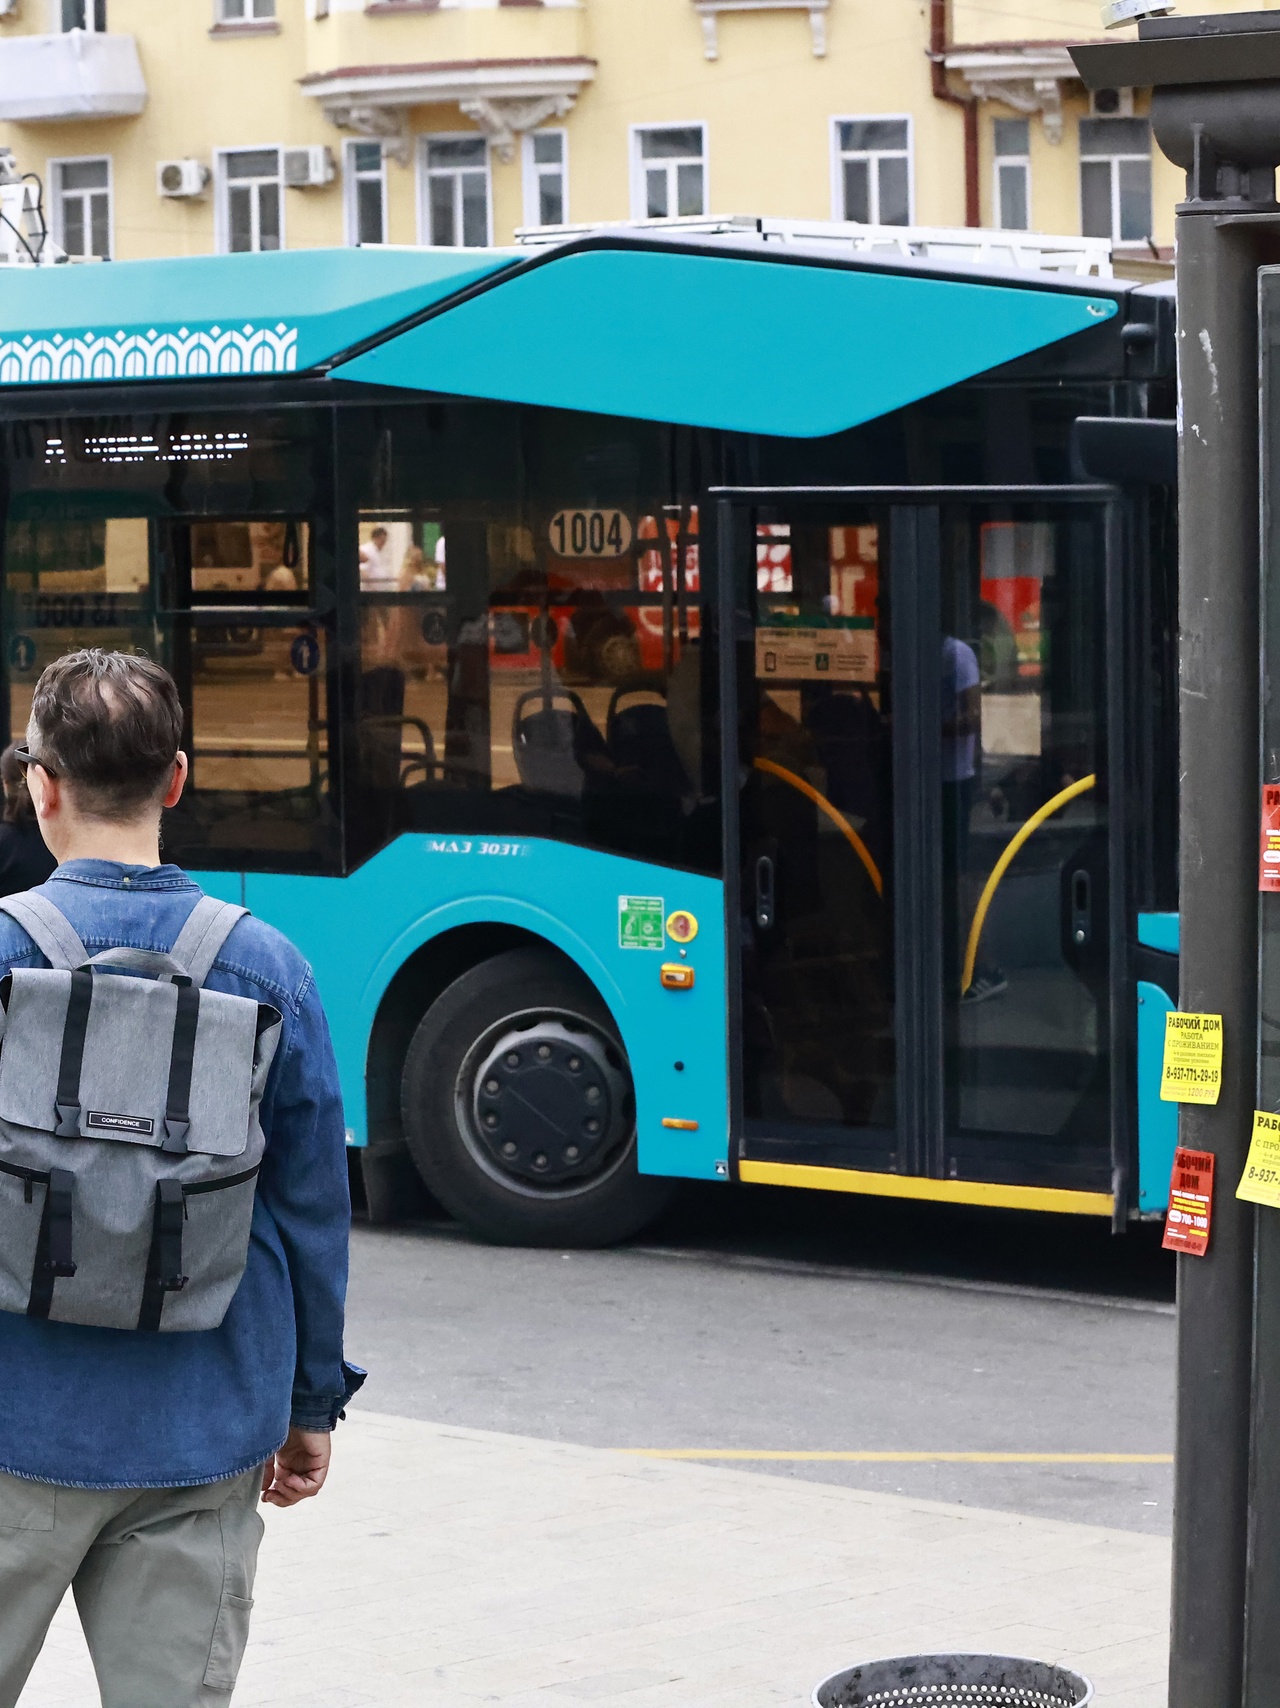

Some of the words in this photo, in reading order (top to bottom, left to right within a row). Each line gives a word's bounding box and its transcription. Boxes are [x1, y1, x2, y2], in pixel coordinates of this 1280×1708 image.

[553, 512, 623, 554] 1004
[1168, 1016, 1201, 1030] РАБОЧИЙ
[1203, 1019, 1220, 1032] ДОМ
[1181, 1031, 1204, 1040] РАБОТА
[1166, 1066, 1218, 1083] 8-937-771-29-19
[101, 1117, 140, 1127] CONFIDENCE
